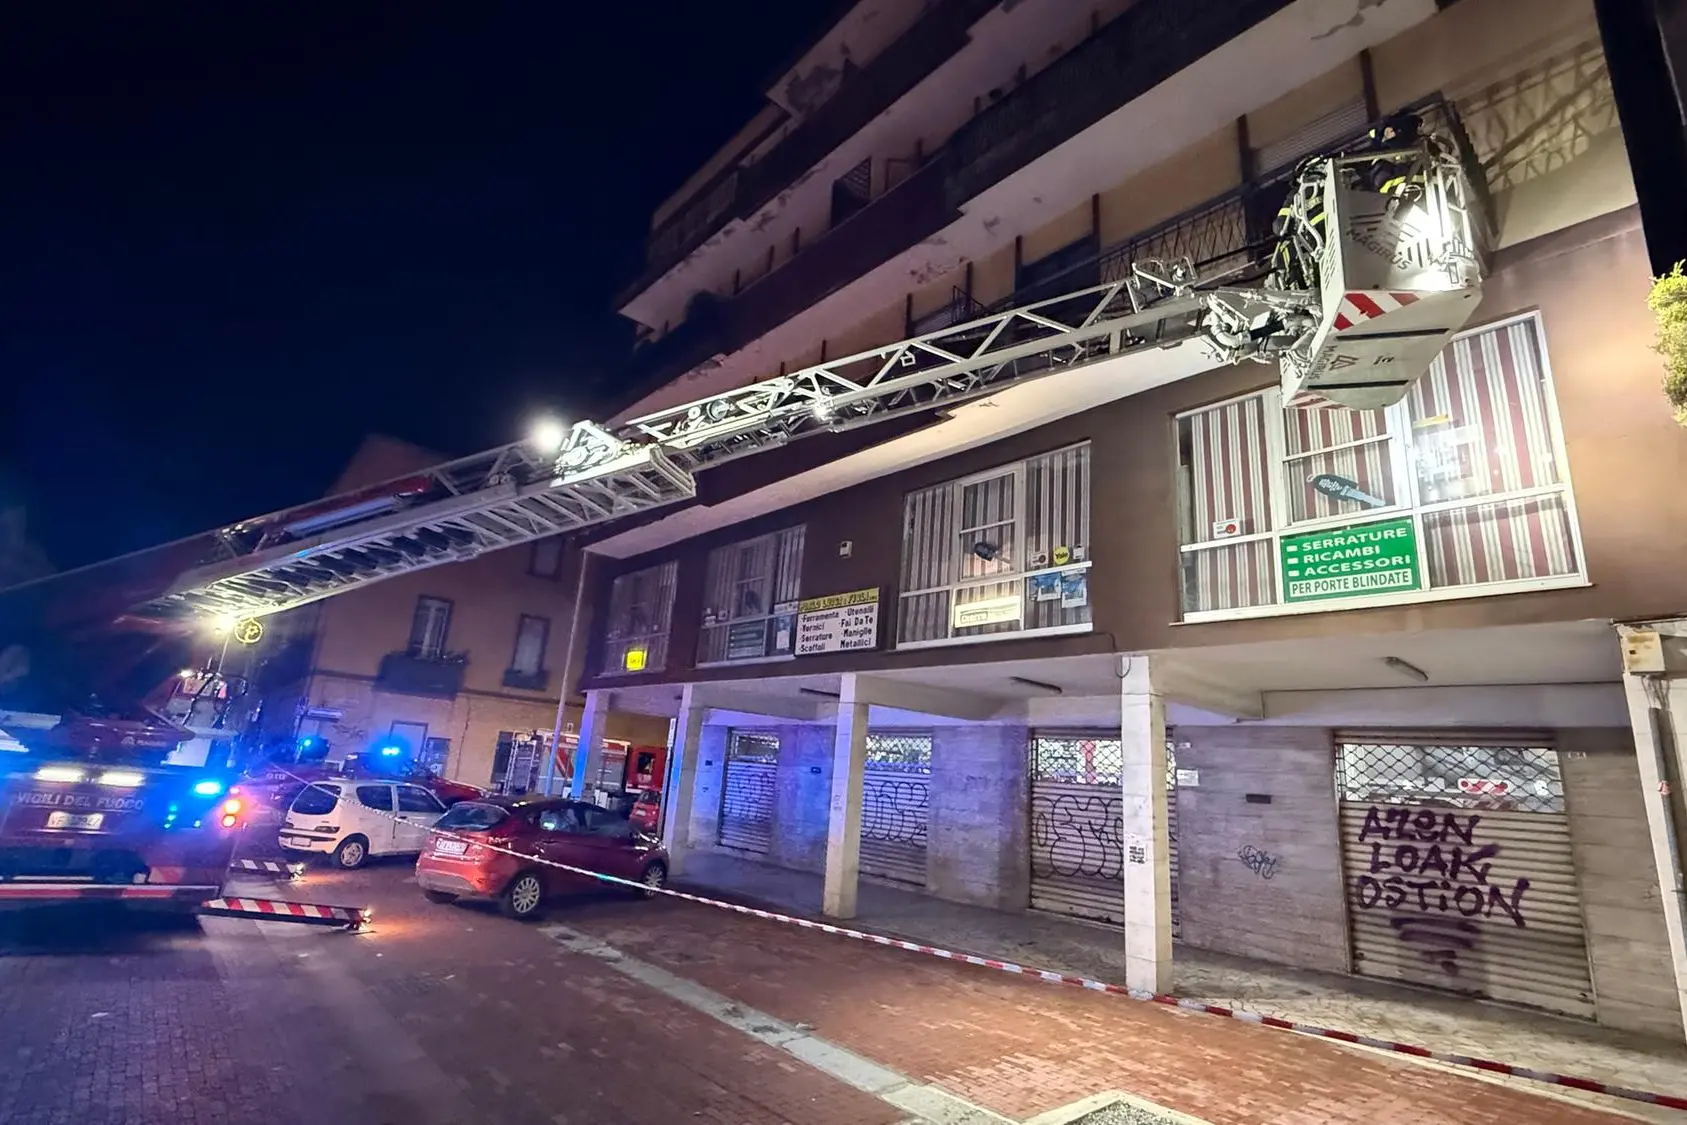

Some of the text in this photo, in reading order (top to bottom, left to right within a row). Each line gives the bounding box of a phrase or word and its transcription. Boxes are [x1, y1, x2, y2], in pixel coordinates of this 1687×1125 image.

[1346, 228, 1411, 270] MAGIRUS
[1302, 528, 1408, 551] SERRATURE
[1303, 545, 1380, 564] RICAMBI
[1304, 555, 1411, 577] ACCESSORI
[1292, 571, 1409, 595] PER PORTE BLINDATE
[18, 791, 144, 810] VIGILI DEL FUOCO
